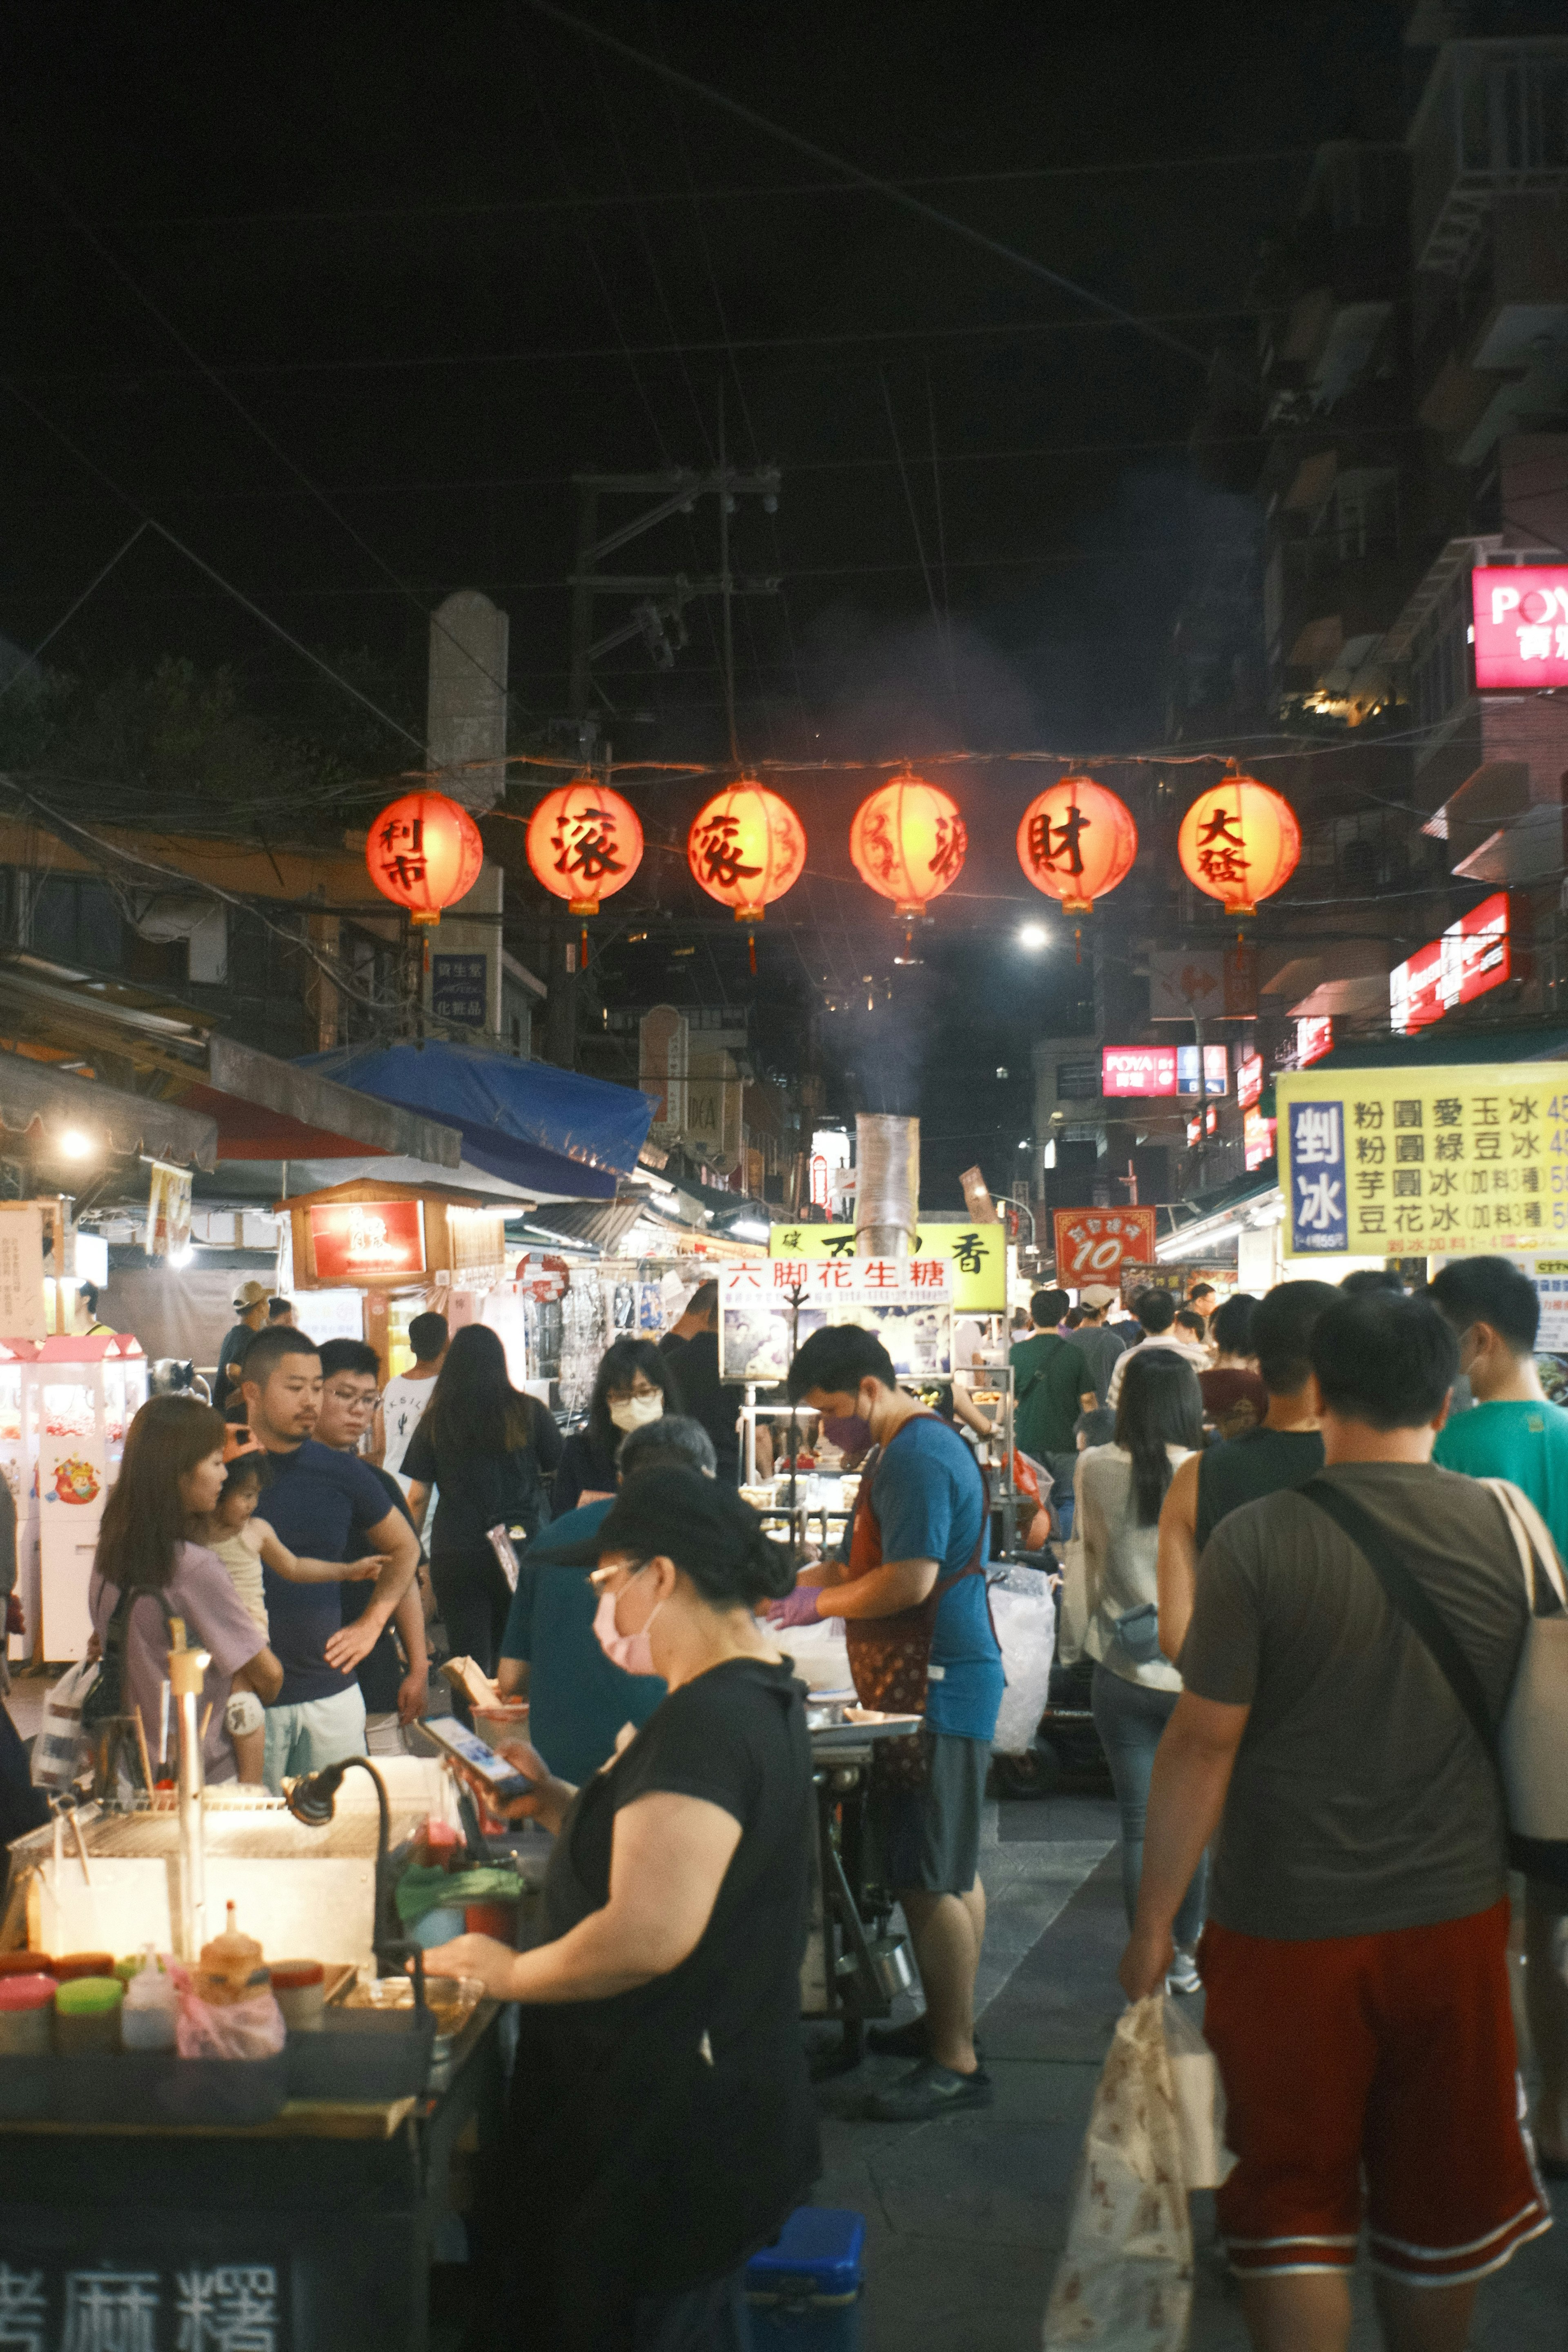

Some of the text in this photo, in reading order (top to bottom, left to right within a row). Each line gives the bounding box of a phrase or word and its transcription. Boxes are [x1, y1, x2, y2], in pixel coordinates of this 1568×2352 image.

[380, 818, 427, 889] 利市
[1027, 806, 1091, 876] 財
[1197, 808, 1250, 884] 大發
[1107, 1056, 1152, 1071] POYA
[1354, 1095, 1539, 1131] 粉圓愛玉冰
[1355, 1130, 1540, 1165] 粉圓綠豆冰
[1072, 1239, 1121, 1271] 10
